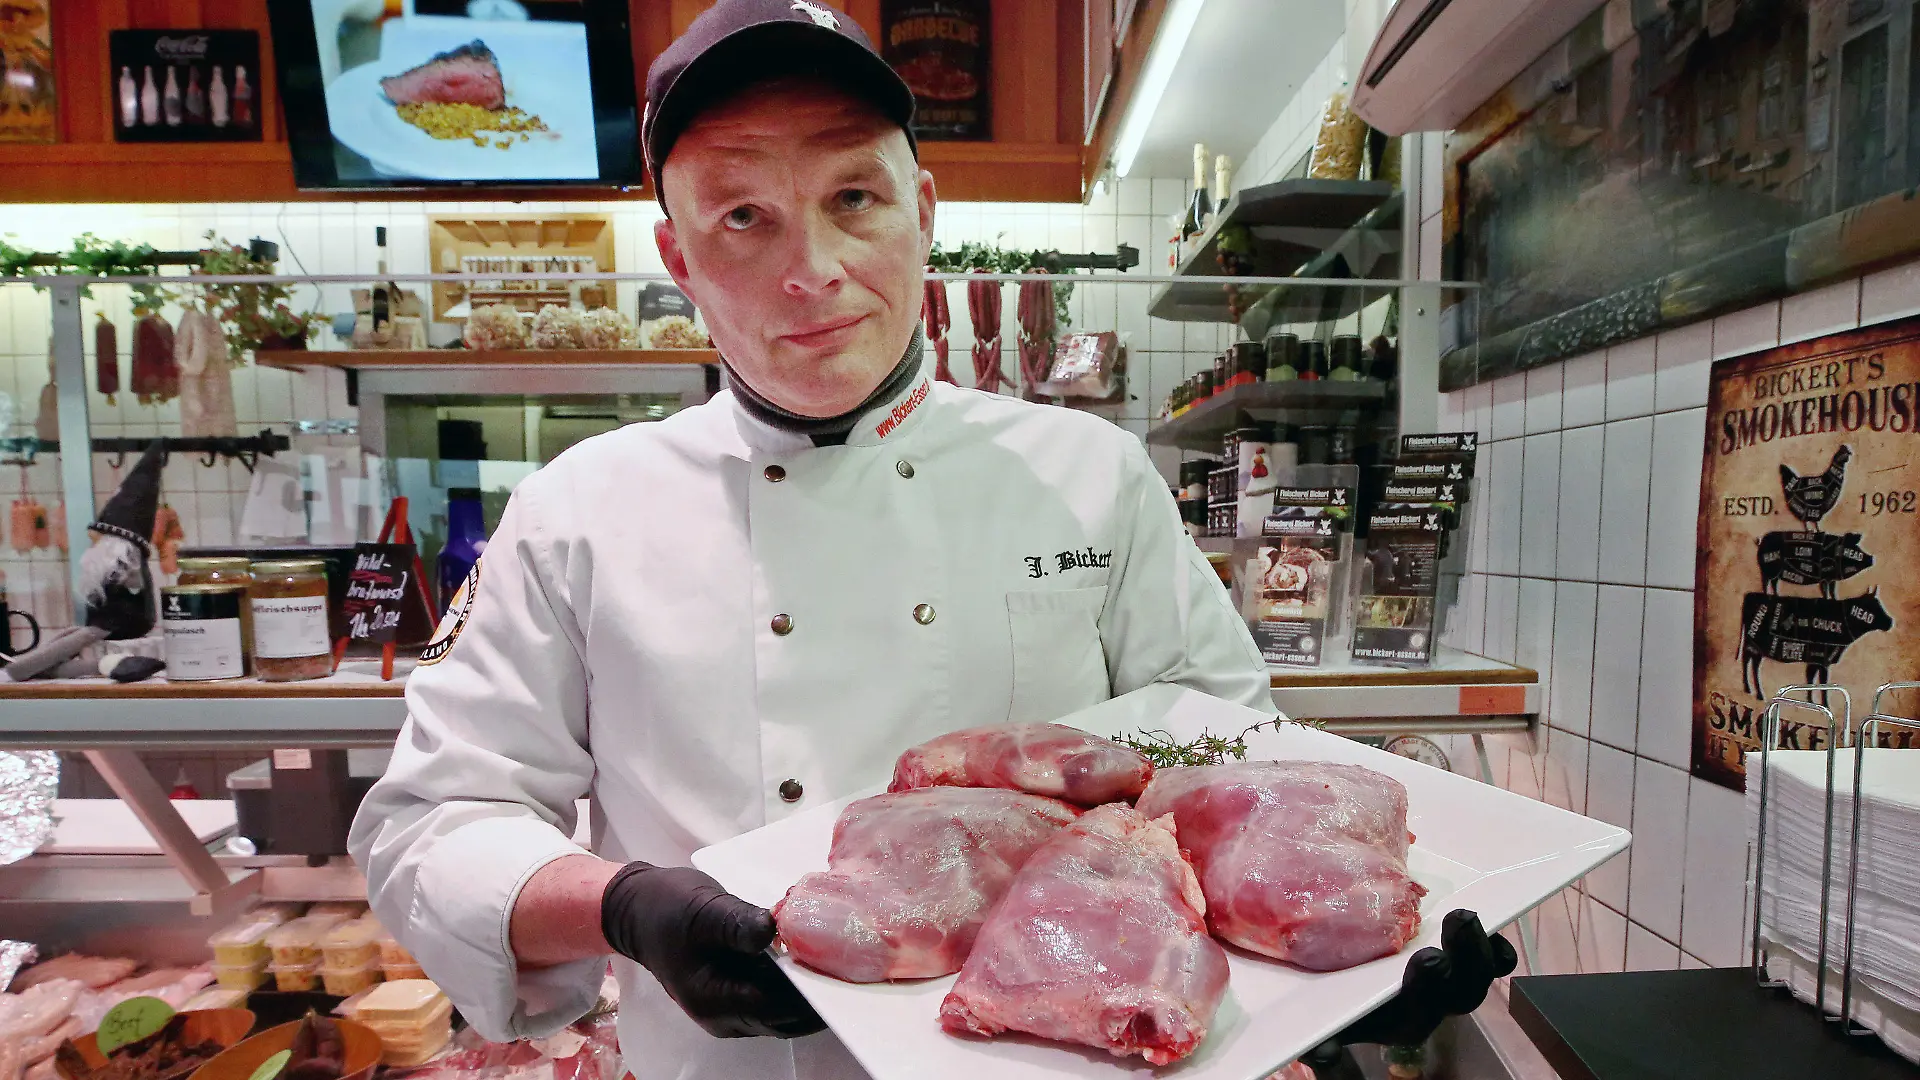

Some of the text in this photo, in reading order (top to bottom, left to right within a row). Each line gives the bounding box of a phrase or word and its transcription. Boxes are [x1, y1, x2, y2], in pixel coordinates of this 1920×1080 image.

[1754, 353, 1886, 401] BICKERT'S
[1309, 489, 1330, 498] Bickert
[1858, 490, 1916, 517] 1962
[1723, 496, 1779, 517] ESTD.
[1400, 516, 1421, 525] Bickert
[1054, 546, 1112, 574] Bickert
[1843, 547, 1864, 562] HEAD
[1747, 603, 1769, 639] ROUND
[1850, 604, 1875, 625] HEAD
[1811, 617, 1843, 634] CHUCK
